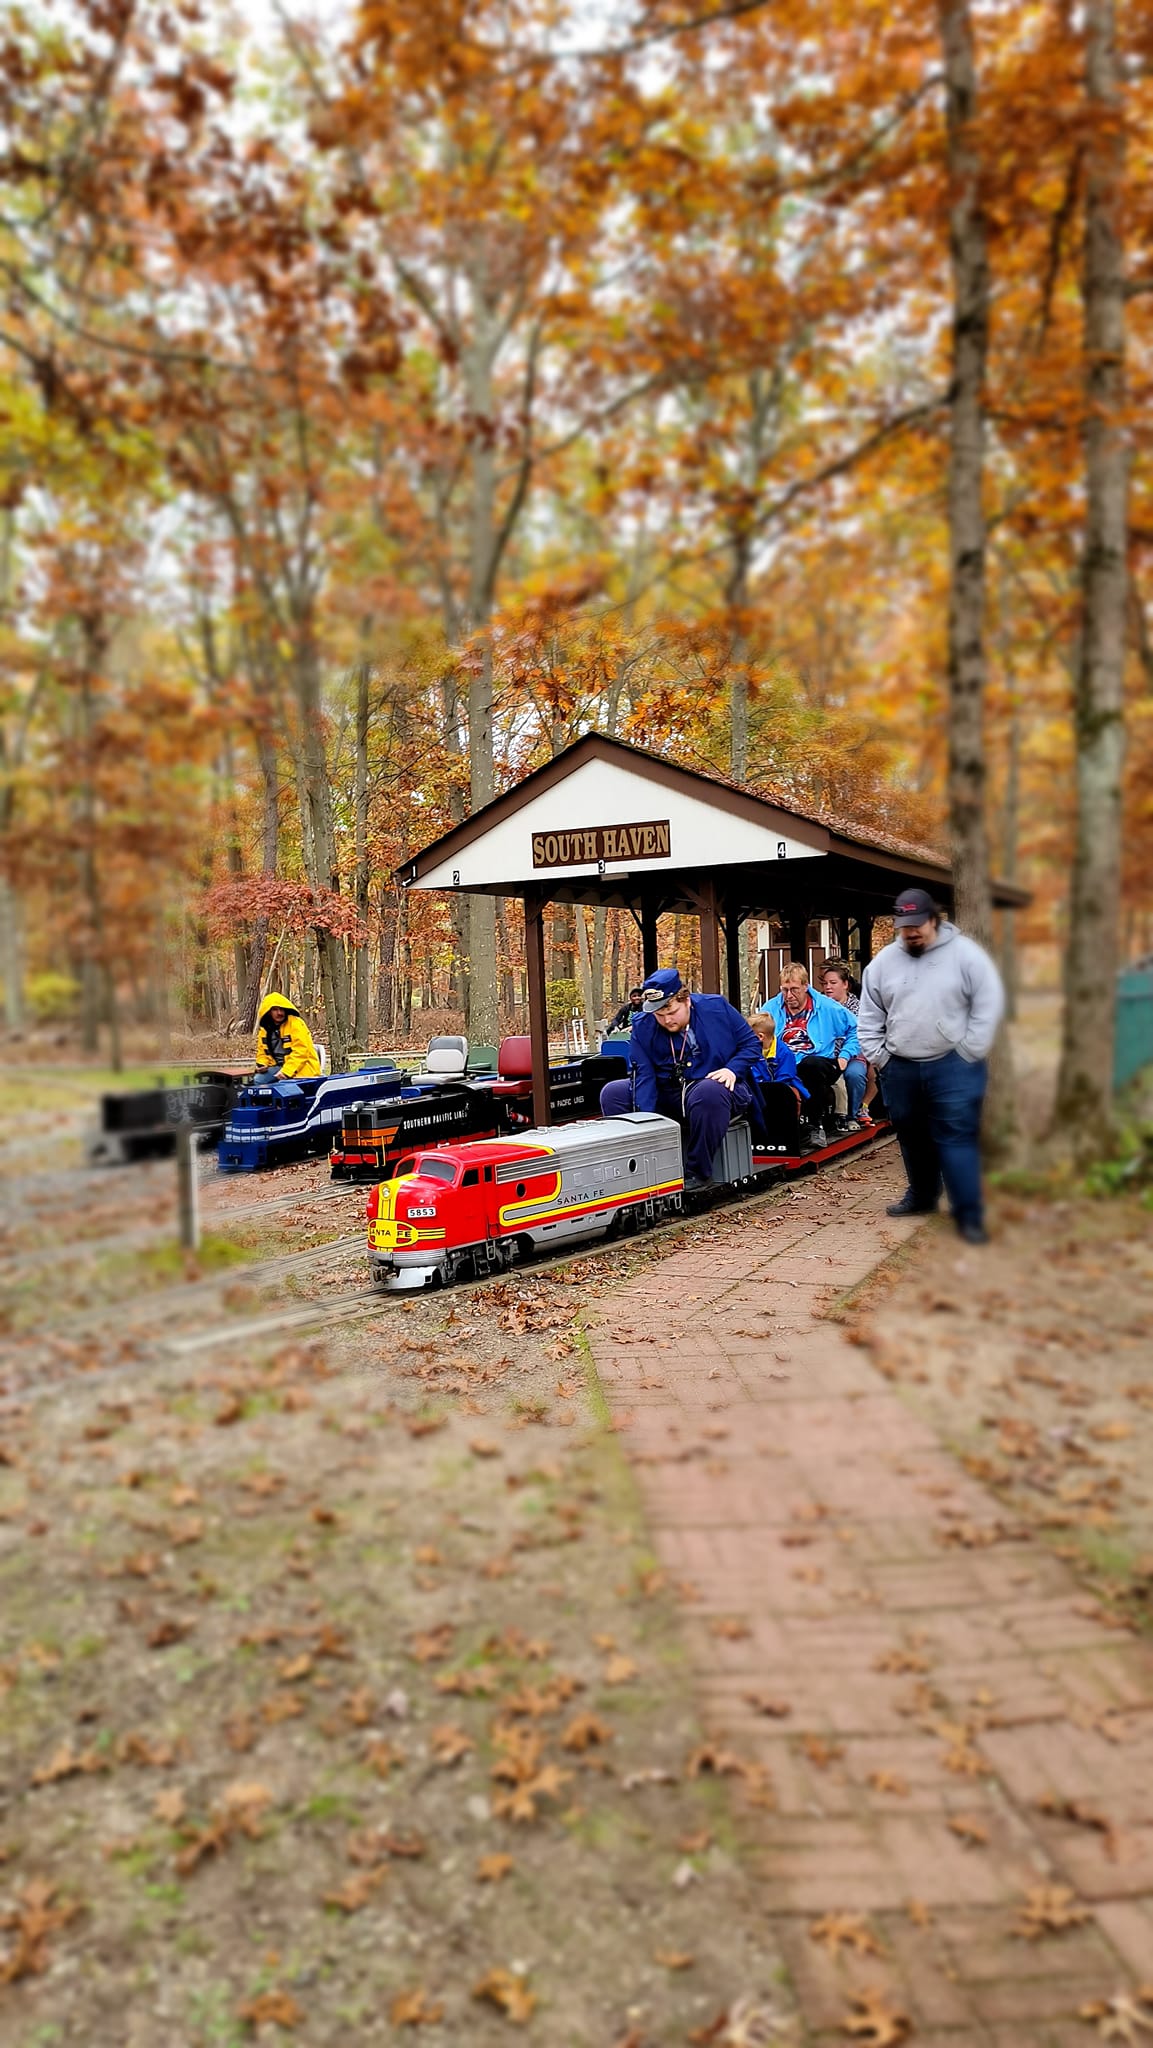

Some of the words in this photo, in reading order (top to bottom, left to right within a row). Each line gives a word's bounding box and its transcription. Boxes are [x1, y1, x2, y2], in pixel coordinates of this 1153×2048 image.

[533, 832, 598, 865] SOUTH
[602, 824, 670, 858] HAVEN
[778, 843, 786, 857] 4
[598, 859, 605, 872] 3
[453, 871, 460, 884] 2
[403, 1116, 431, 1130] SOUTHERN
[557, 1192, 589, 1206] SANTA
[593, 1188, 605, 1198] FE
[409, 1208, 435, 1217] 5853
[397, 1230, 412, 1238] FE
